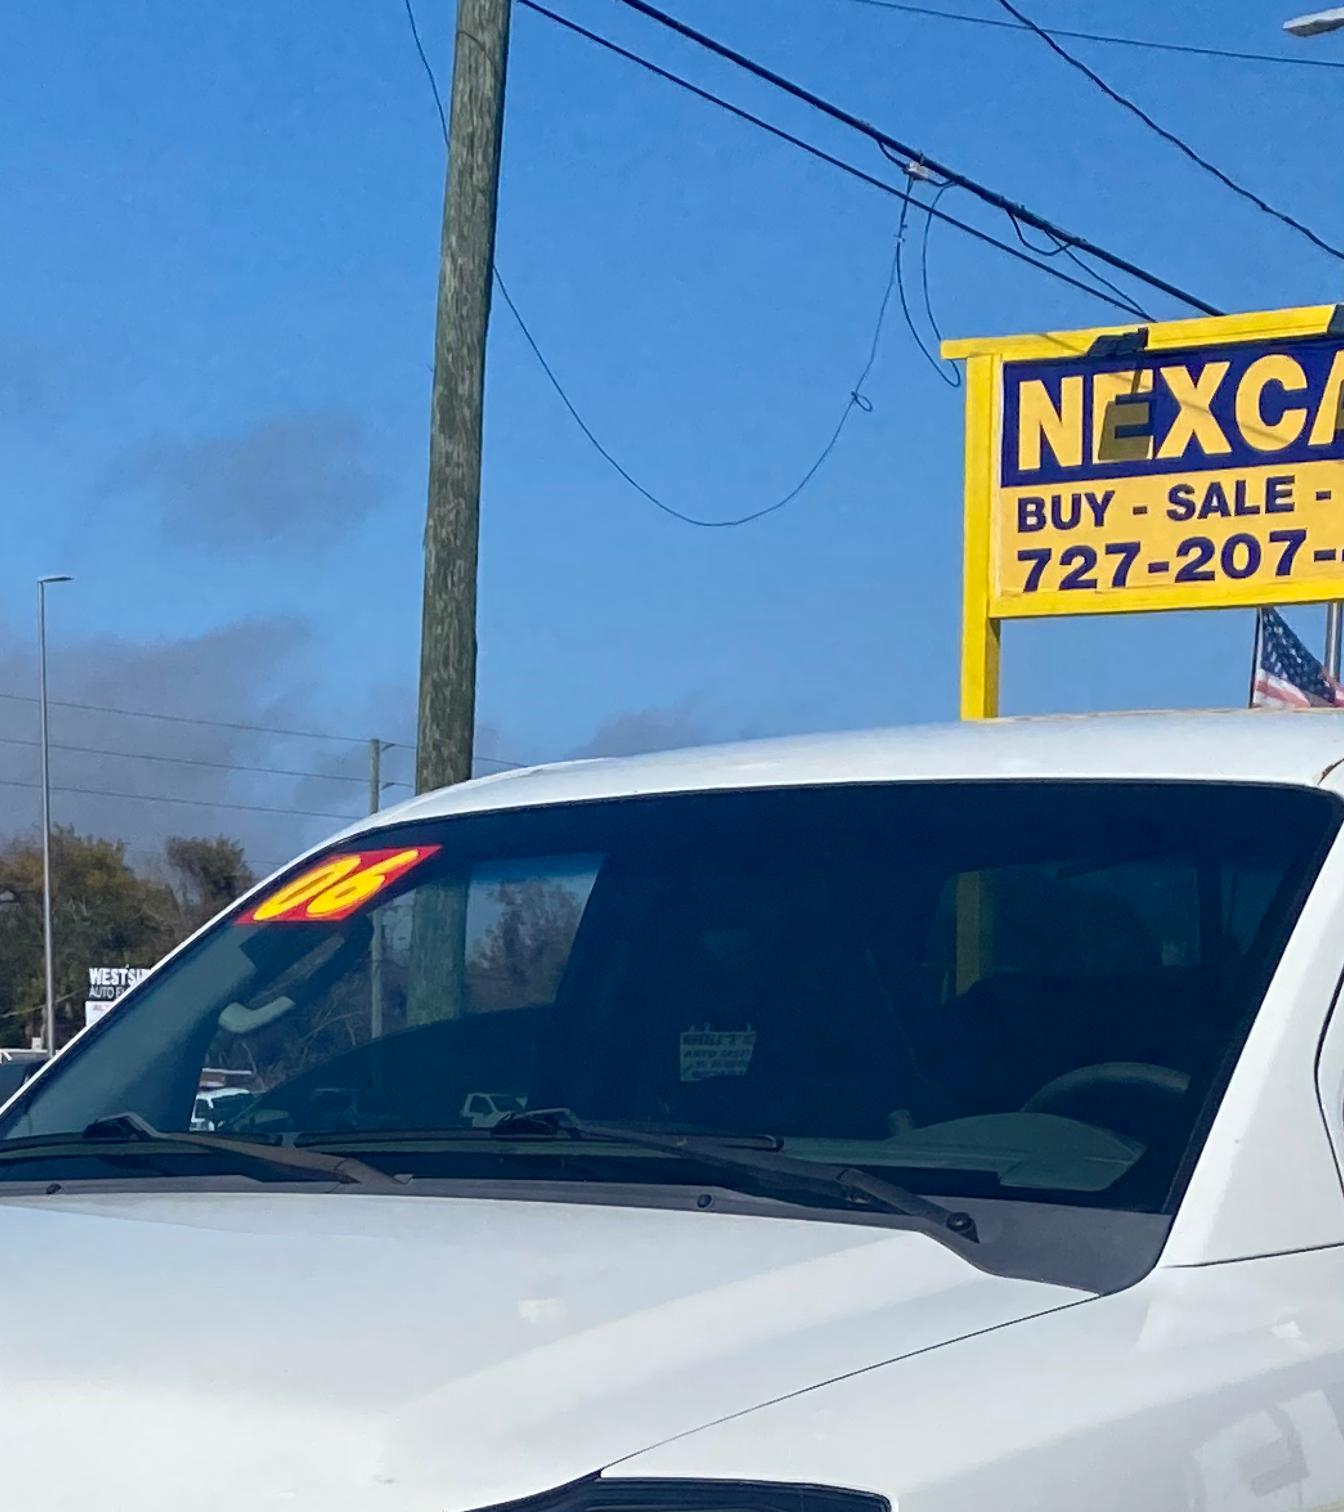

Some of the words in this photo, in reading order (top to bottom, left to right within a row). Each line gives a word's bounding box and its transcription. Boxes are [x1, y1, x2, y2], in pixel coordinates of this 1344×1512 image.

[1016, 490, 1115, 533] BUY
[1167, 475, 1296, 521] SALE
[253, 848, 419, 921] 06
[89, 986, 115, 999] AUTO
